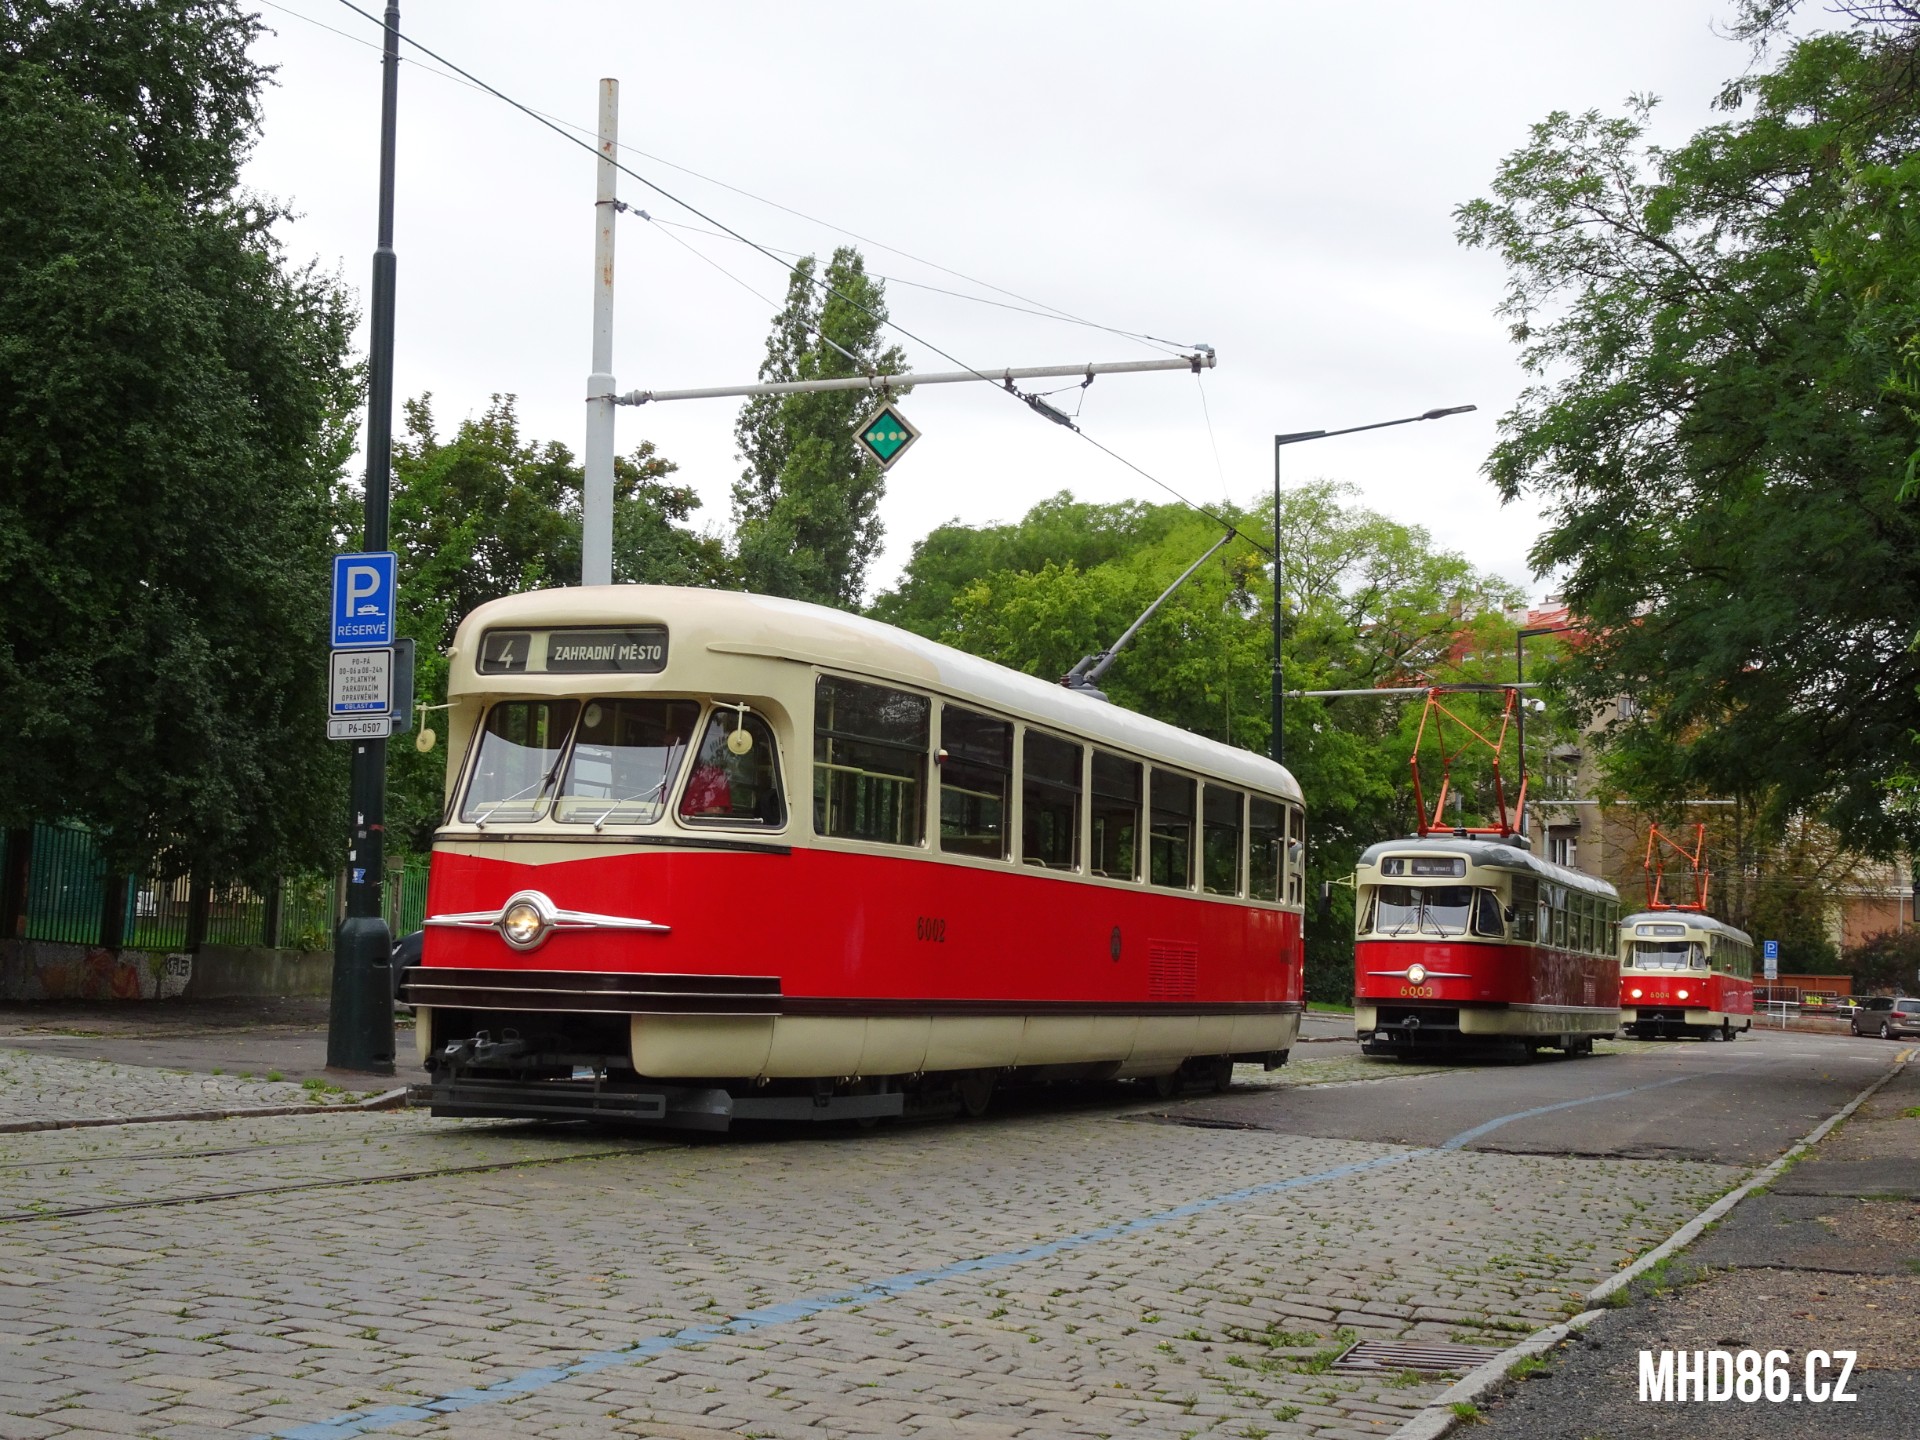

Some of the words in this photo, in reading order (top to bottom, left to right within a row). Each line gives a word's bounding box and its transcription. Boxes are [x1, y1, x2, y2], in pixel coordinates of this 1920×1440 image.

[345, 566, 381, 618] P
[337, 622, 387, 636] RÉSERVÉ
[498, 640, 514, 668] 4
[555, 643, 616, 661] ZAHRADNÍ
[618, 645, 662, 660] MĚSTO
[348, 723, 381, 733] P6-0507
[1389, 860, 1398, 874] X
[917, 916, 946, 942] 6002
[1400, 986, 1433, 997] 6003
